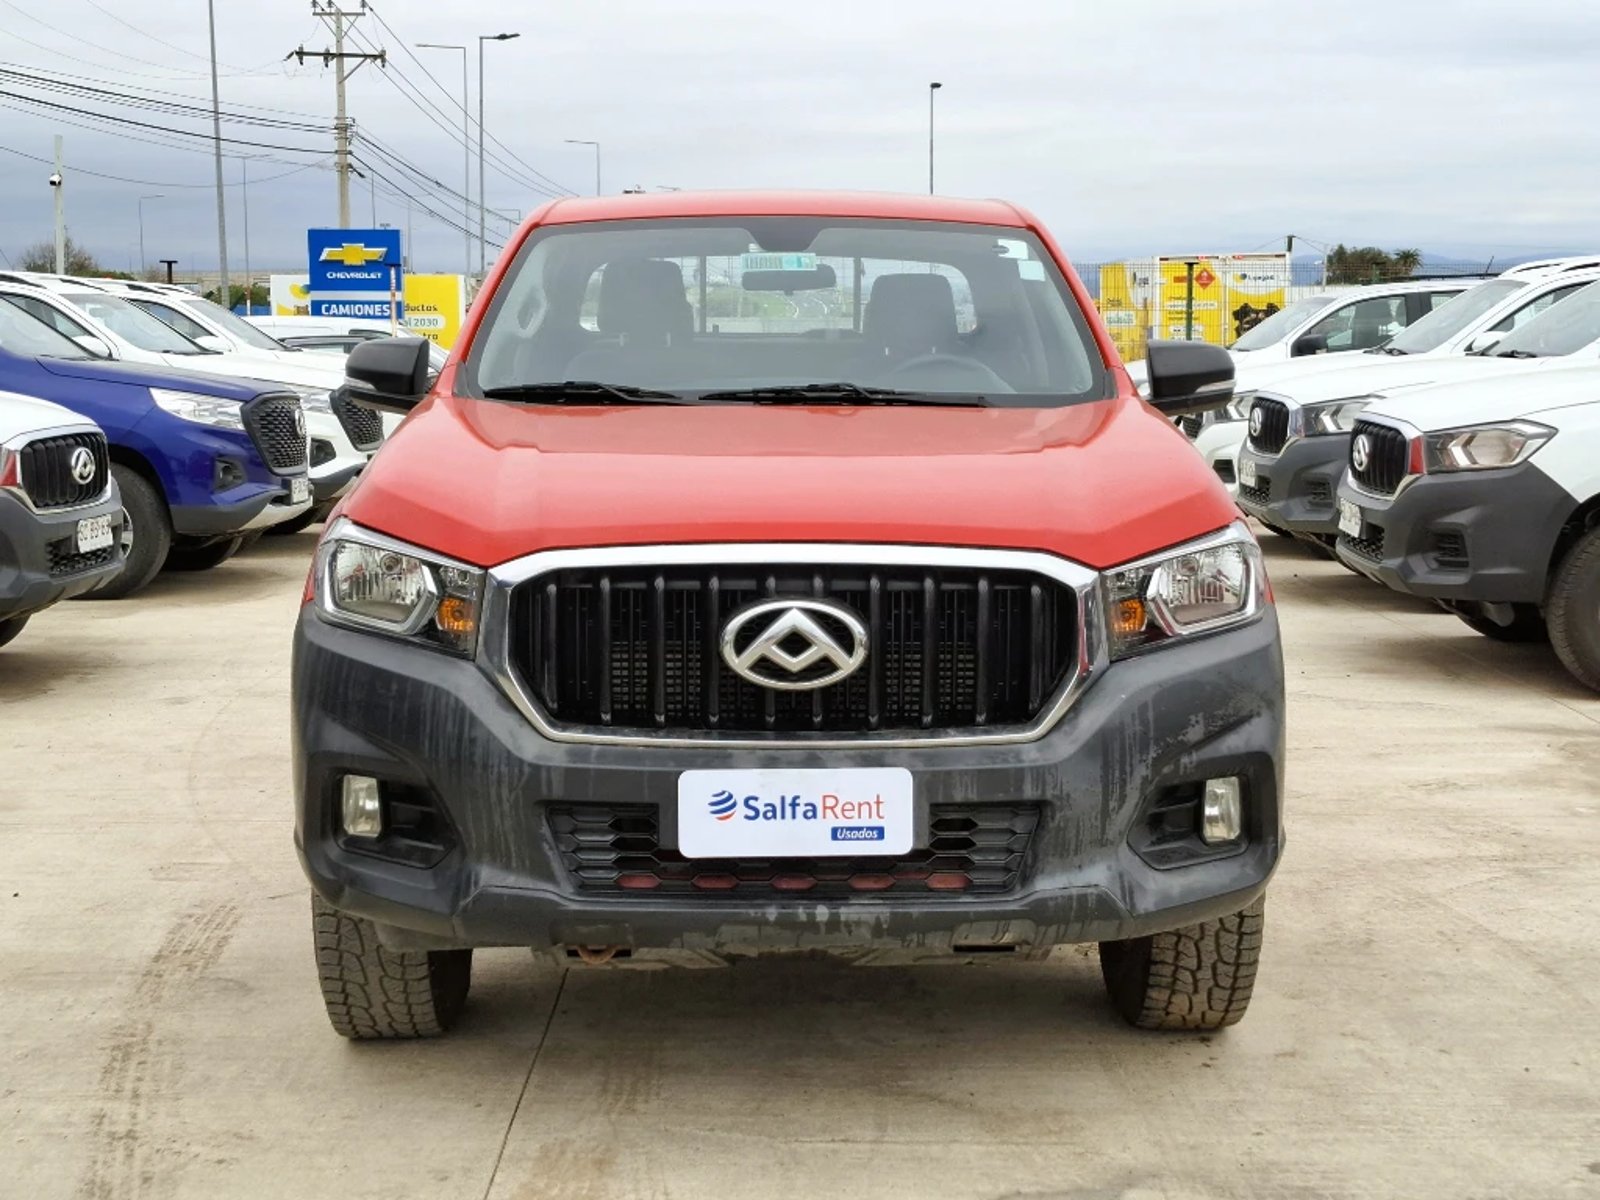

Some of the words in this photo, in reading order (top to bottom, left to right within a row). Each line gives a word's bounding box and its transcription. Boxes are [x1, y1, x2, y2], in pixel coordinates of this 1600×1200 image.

[326, 271, 383, 279] CHEVROLET
[321, 304, 391, 316] CAMIONES
[413, 318, 439, 327] 2030
[743, 794, 885, 821] SalfaRent
[836, 827, 879, 840] Usados
